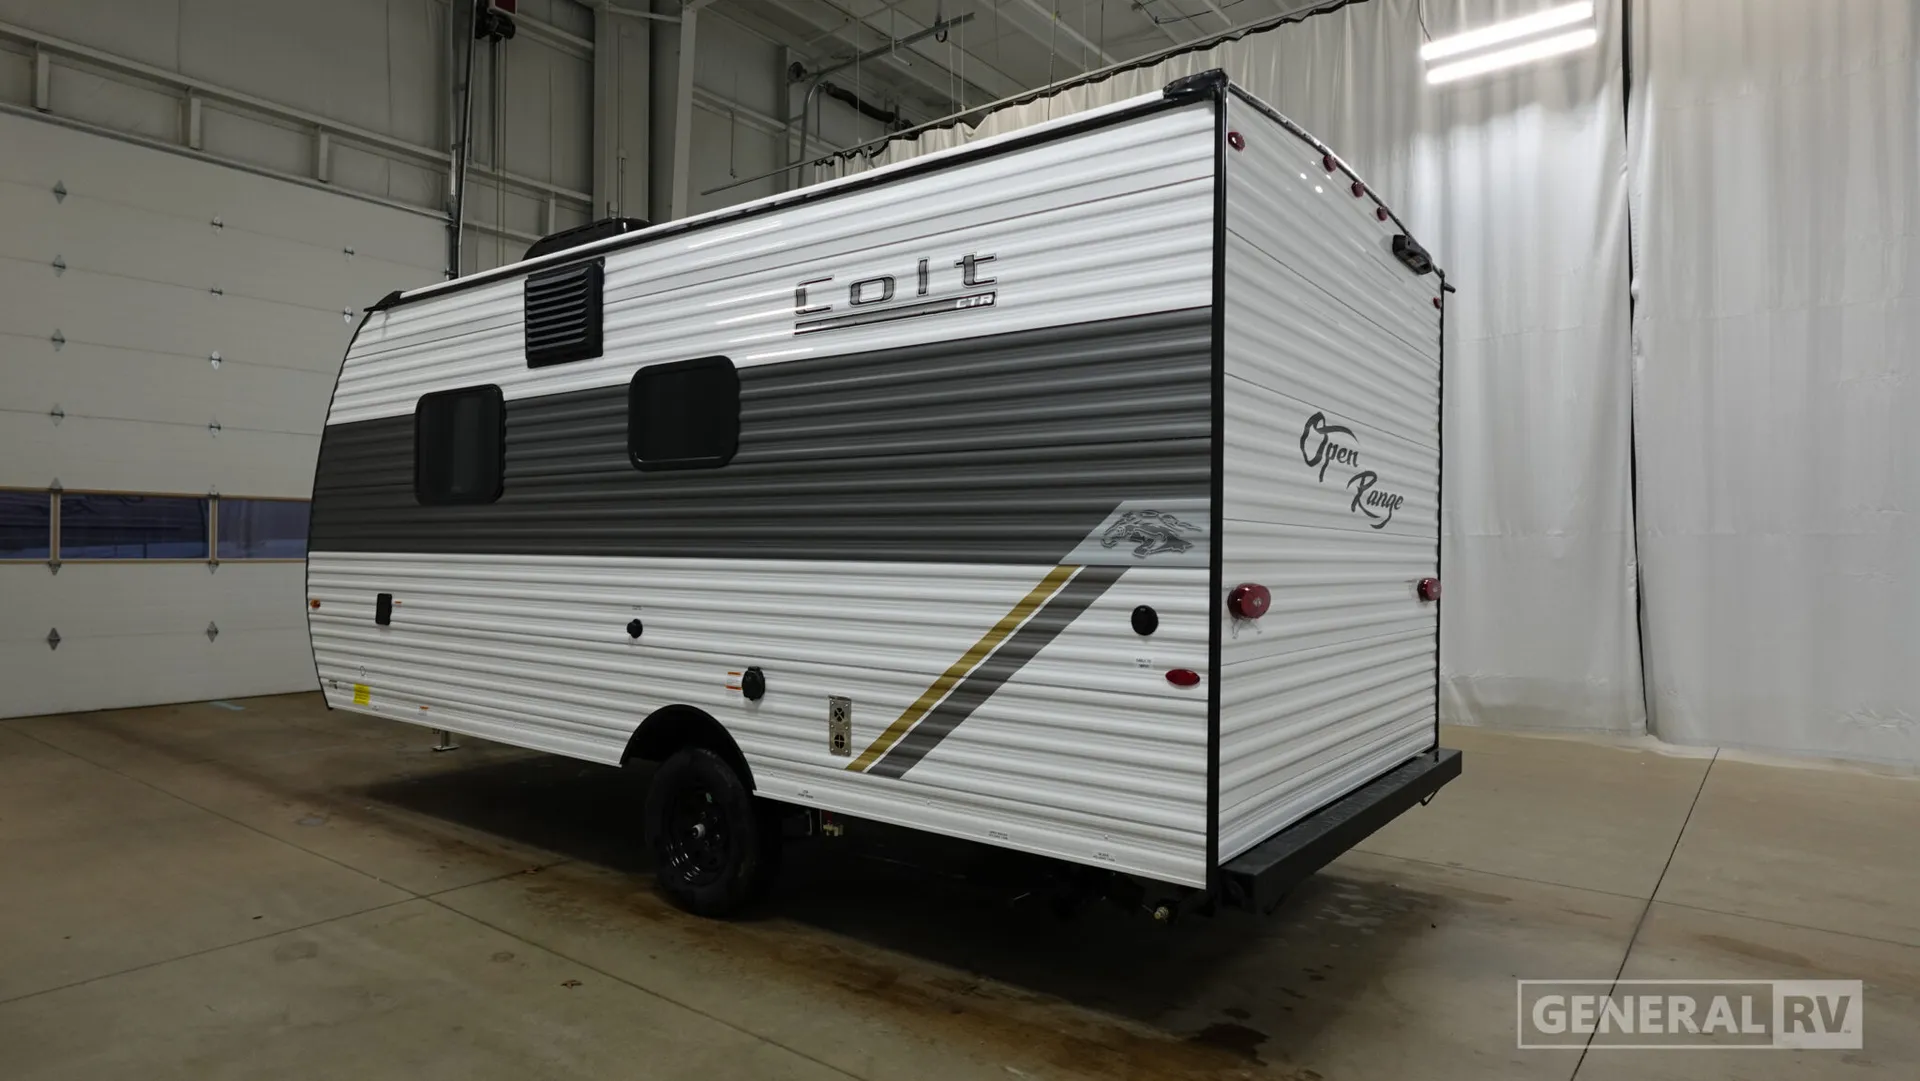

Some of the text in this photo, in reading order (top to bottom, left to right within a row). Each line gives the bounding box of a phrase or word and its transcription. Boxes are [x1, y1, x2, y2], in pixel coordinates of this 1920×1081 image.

[794, 253, 996, 315] Colt
[956, 294, 994, 309] CTR
[1300, 411, 1359, 483] Open
[1346, 470, 1404, 530] Range
